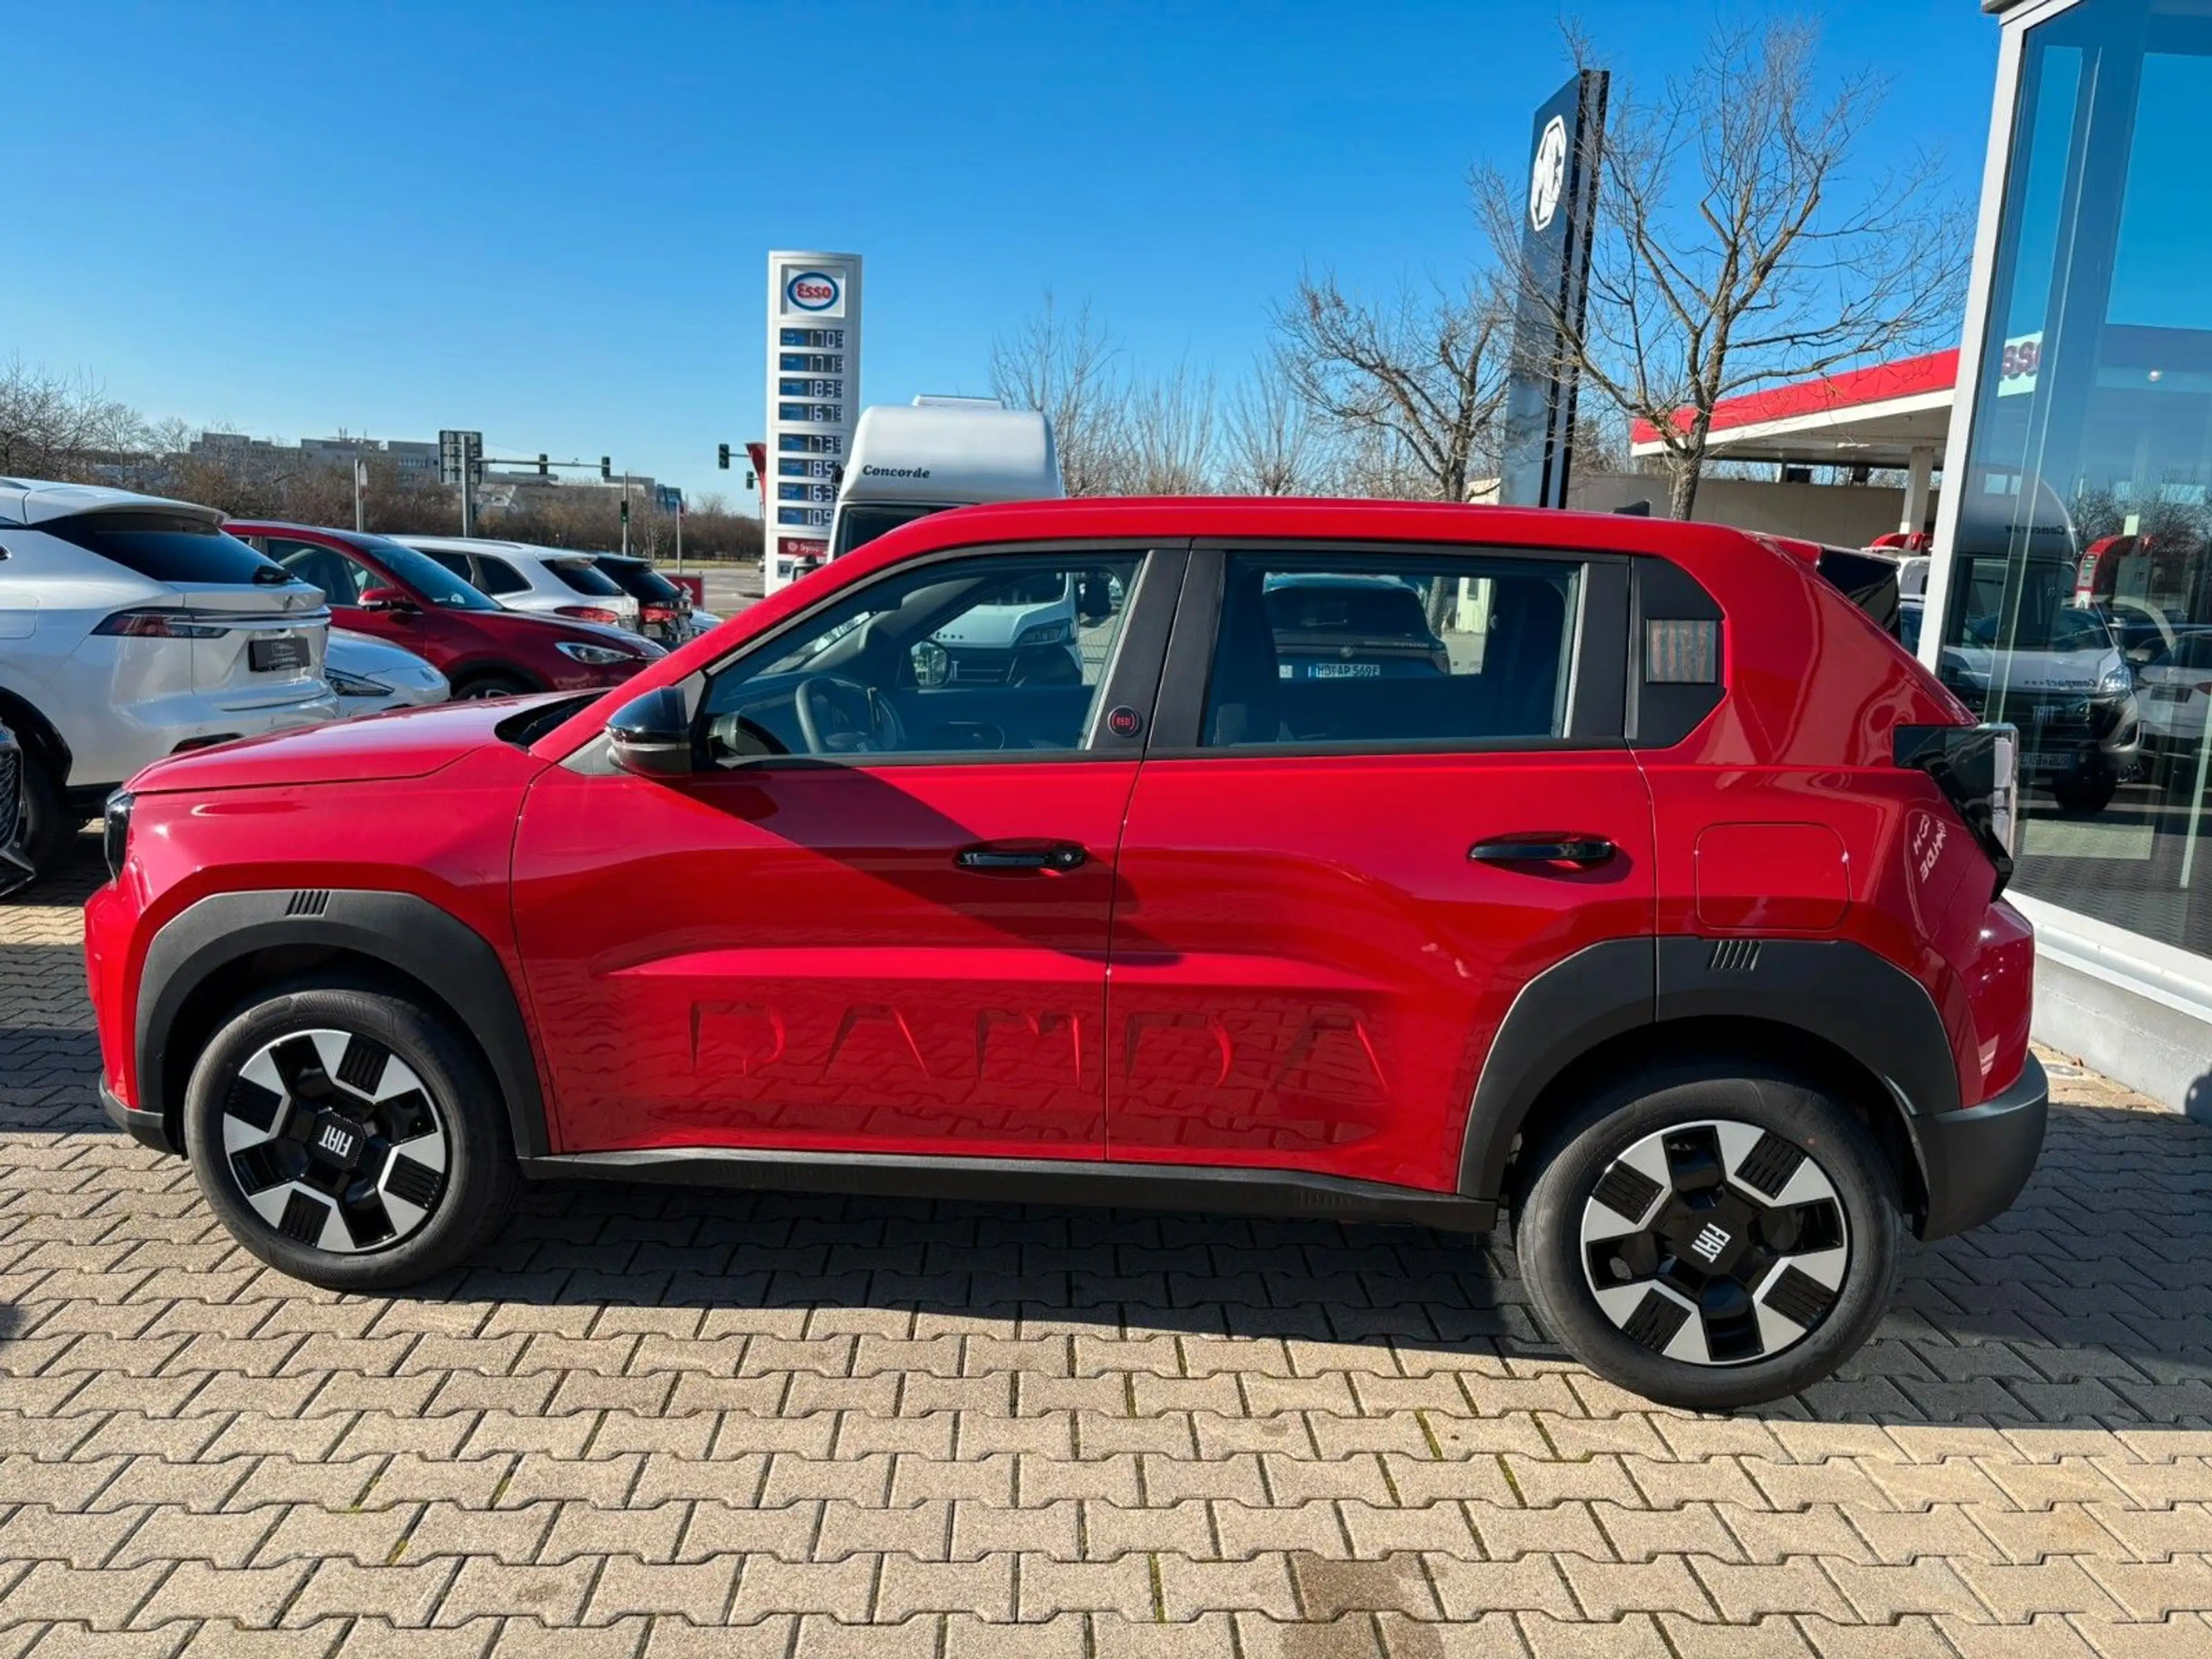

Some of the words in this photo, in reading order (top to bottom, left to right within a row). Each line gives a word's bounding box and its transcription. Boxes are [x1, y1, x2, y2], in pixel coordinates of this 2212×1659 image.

[796, 282, 832, 300] Esso
[862, 464, 930, 479] Concorde
[689, 1001, 1389, 1092] PANDA
[318, 1124, 354, 1158] FIAT
[1691, 1222, 1732, 1263] FIAT
